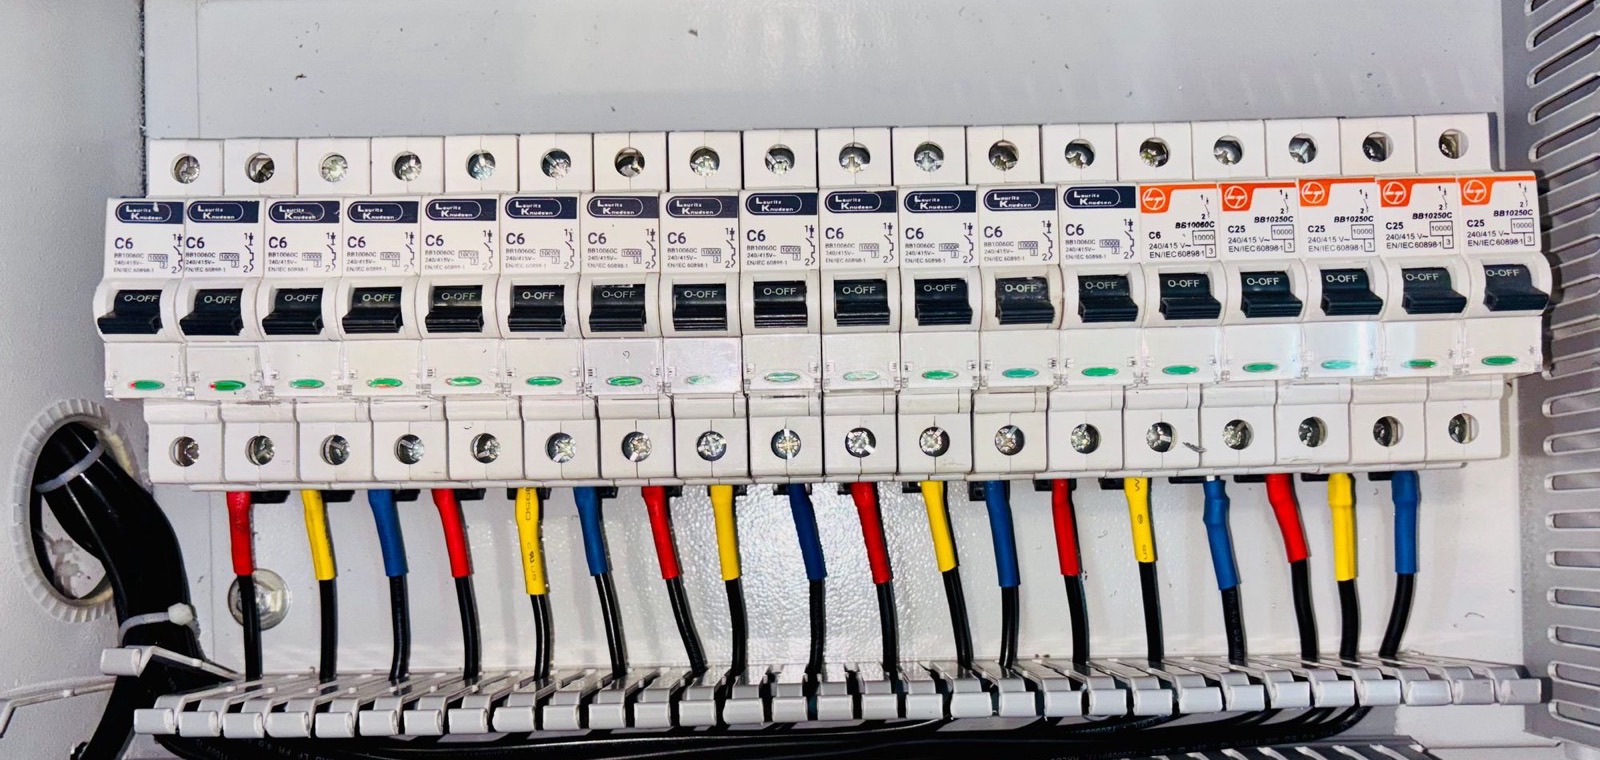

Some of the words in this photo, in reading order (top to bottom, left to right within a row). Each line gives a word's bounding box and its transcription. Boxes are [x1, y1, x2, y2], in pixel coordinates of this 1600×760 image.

[747, 230, 765, 241] C6
[825, 228, 843, 239] C6
[906, 228, 924, 239] C6
[984, 226, 1002, 238] C6
[1065, 224, 1084, 236] C6
[115, 237, 133, 249] C6
[186, 237, 204, 249] C6
[269, 237, 287, 248] C6
[348, 236, 366, 248] C6
[425, 235, 444, 246] C6
[506, 233, 525, 244] C6
[588, 232, 606, 244] C6
[668, 232, 686, 244] C6
